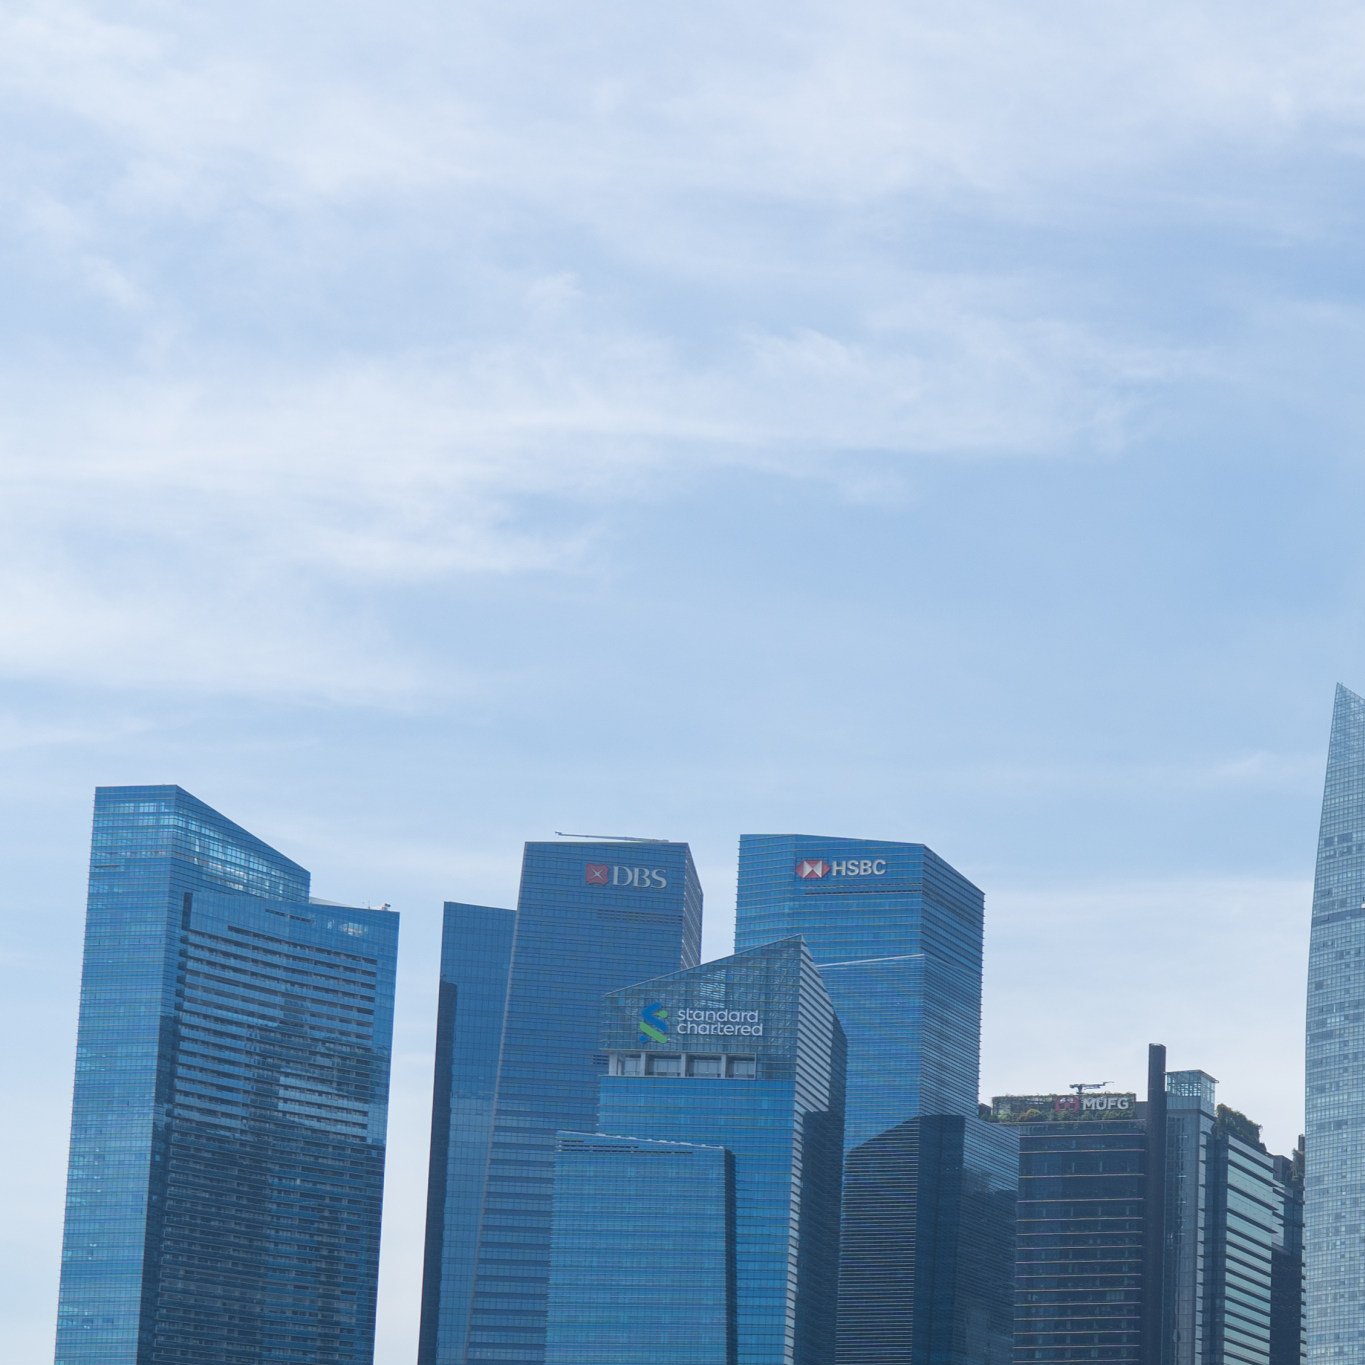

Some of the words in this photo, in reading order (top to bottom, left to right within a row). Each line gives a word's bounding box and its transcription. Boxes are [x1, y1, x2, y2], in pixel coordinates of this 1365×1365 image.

[831, 859, 887, 877] HSBC
[612, 865, 668, 890] DBS
[677, 1008, 759, 1024] standard
[676, 1022, 764, 1037] chartered
[1082, 1096, 1129, 1111] MUFG
